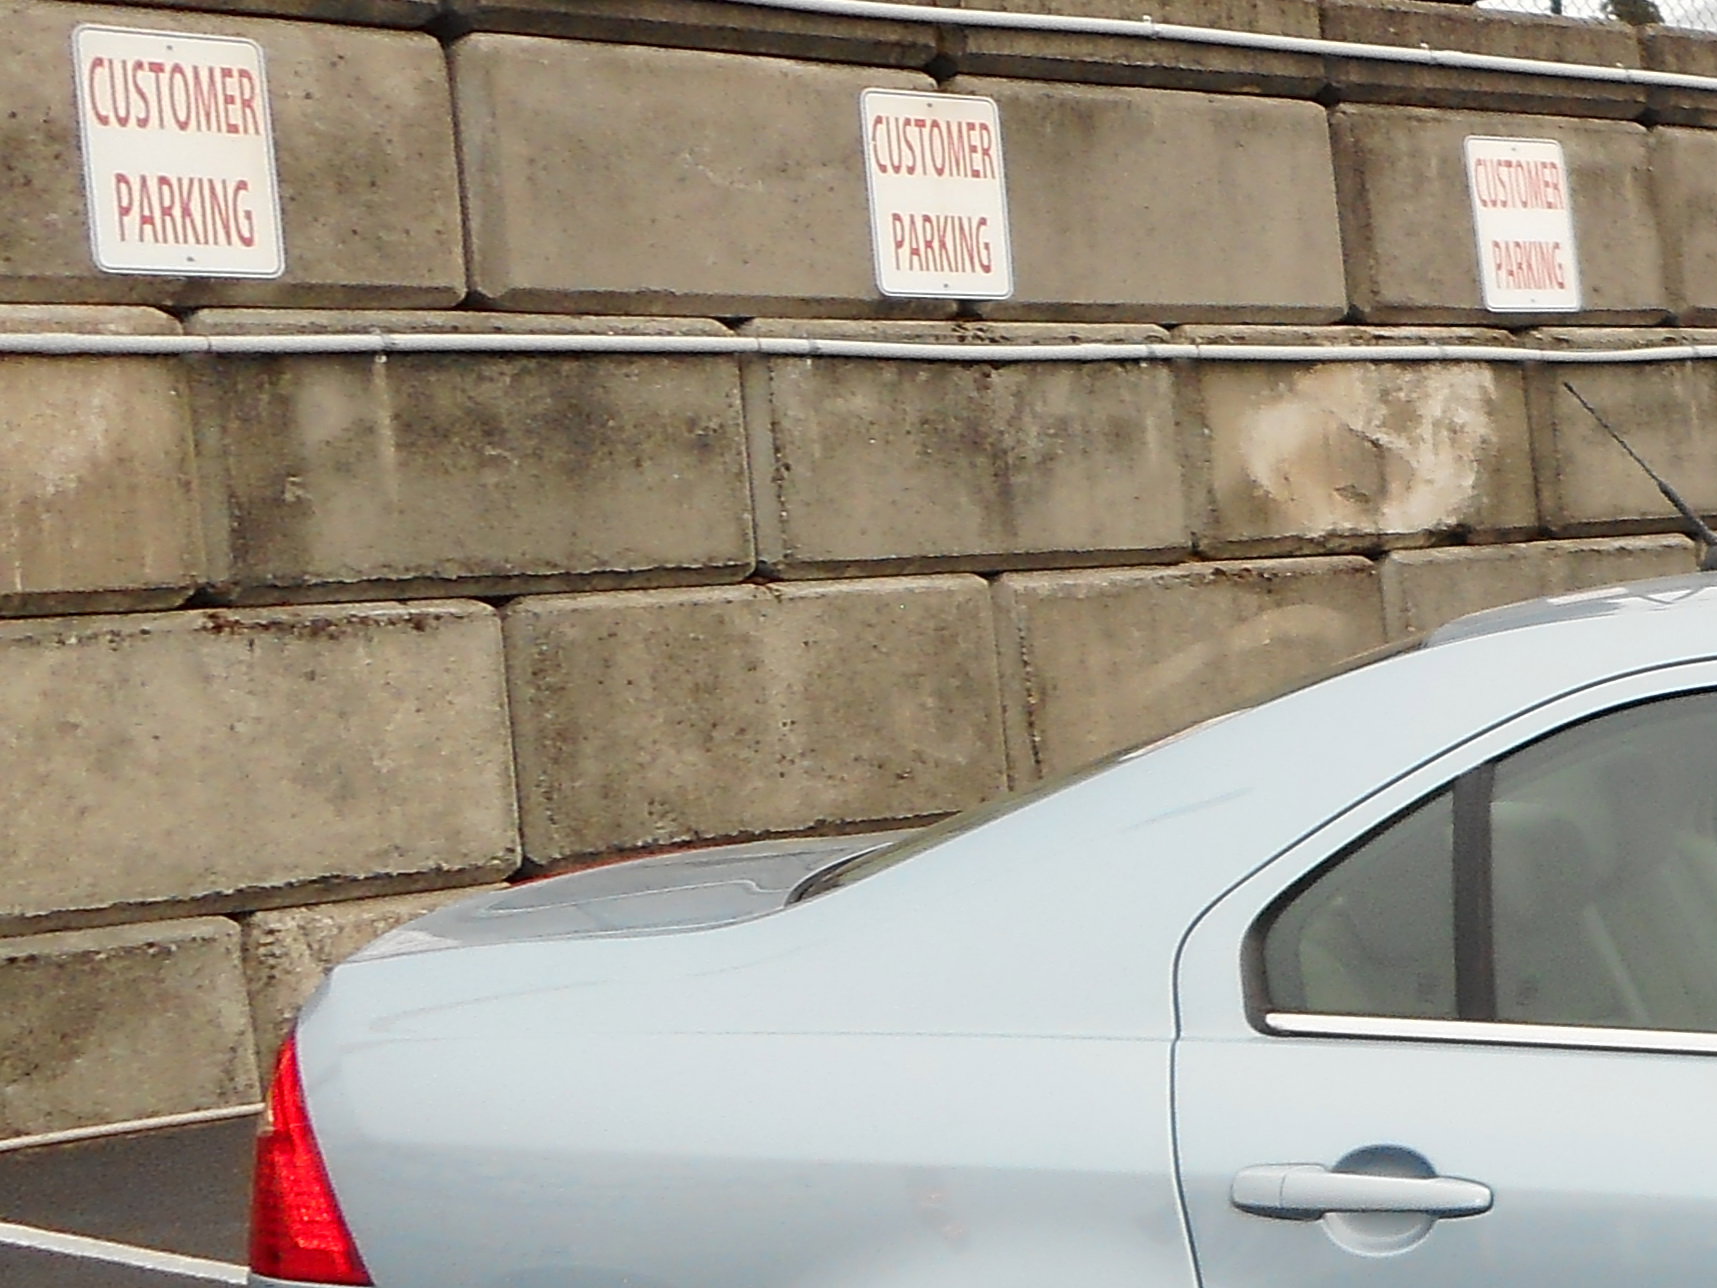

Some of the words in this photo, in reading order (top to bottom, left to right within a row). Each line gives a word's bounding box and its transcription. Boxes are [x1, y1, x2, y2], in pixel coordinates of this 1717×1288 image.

[88, 56, 261, 136] CUSTOMER
[870, 114, 997, 180] CUSTOMER
[114, 172, 255, 248] PARKING
[1474, 158, 1565, 210] CUSTOMER
[891, 212, 993, 274] PARKING
[1492, 239, 1566, 290] PARKING
